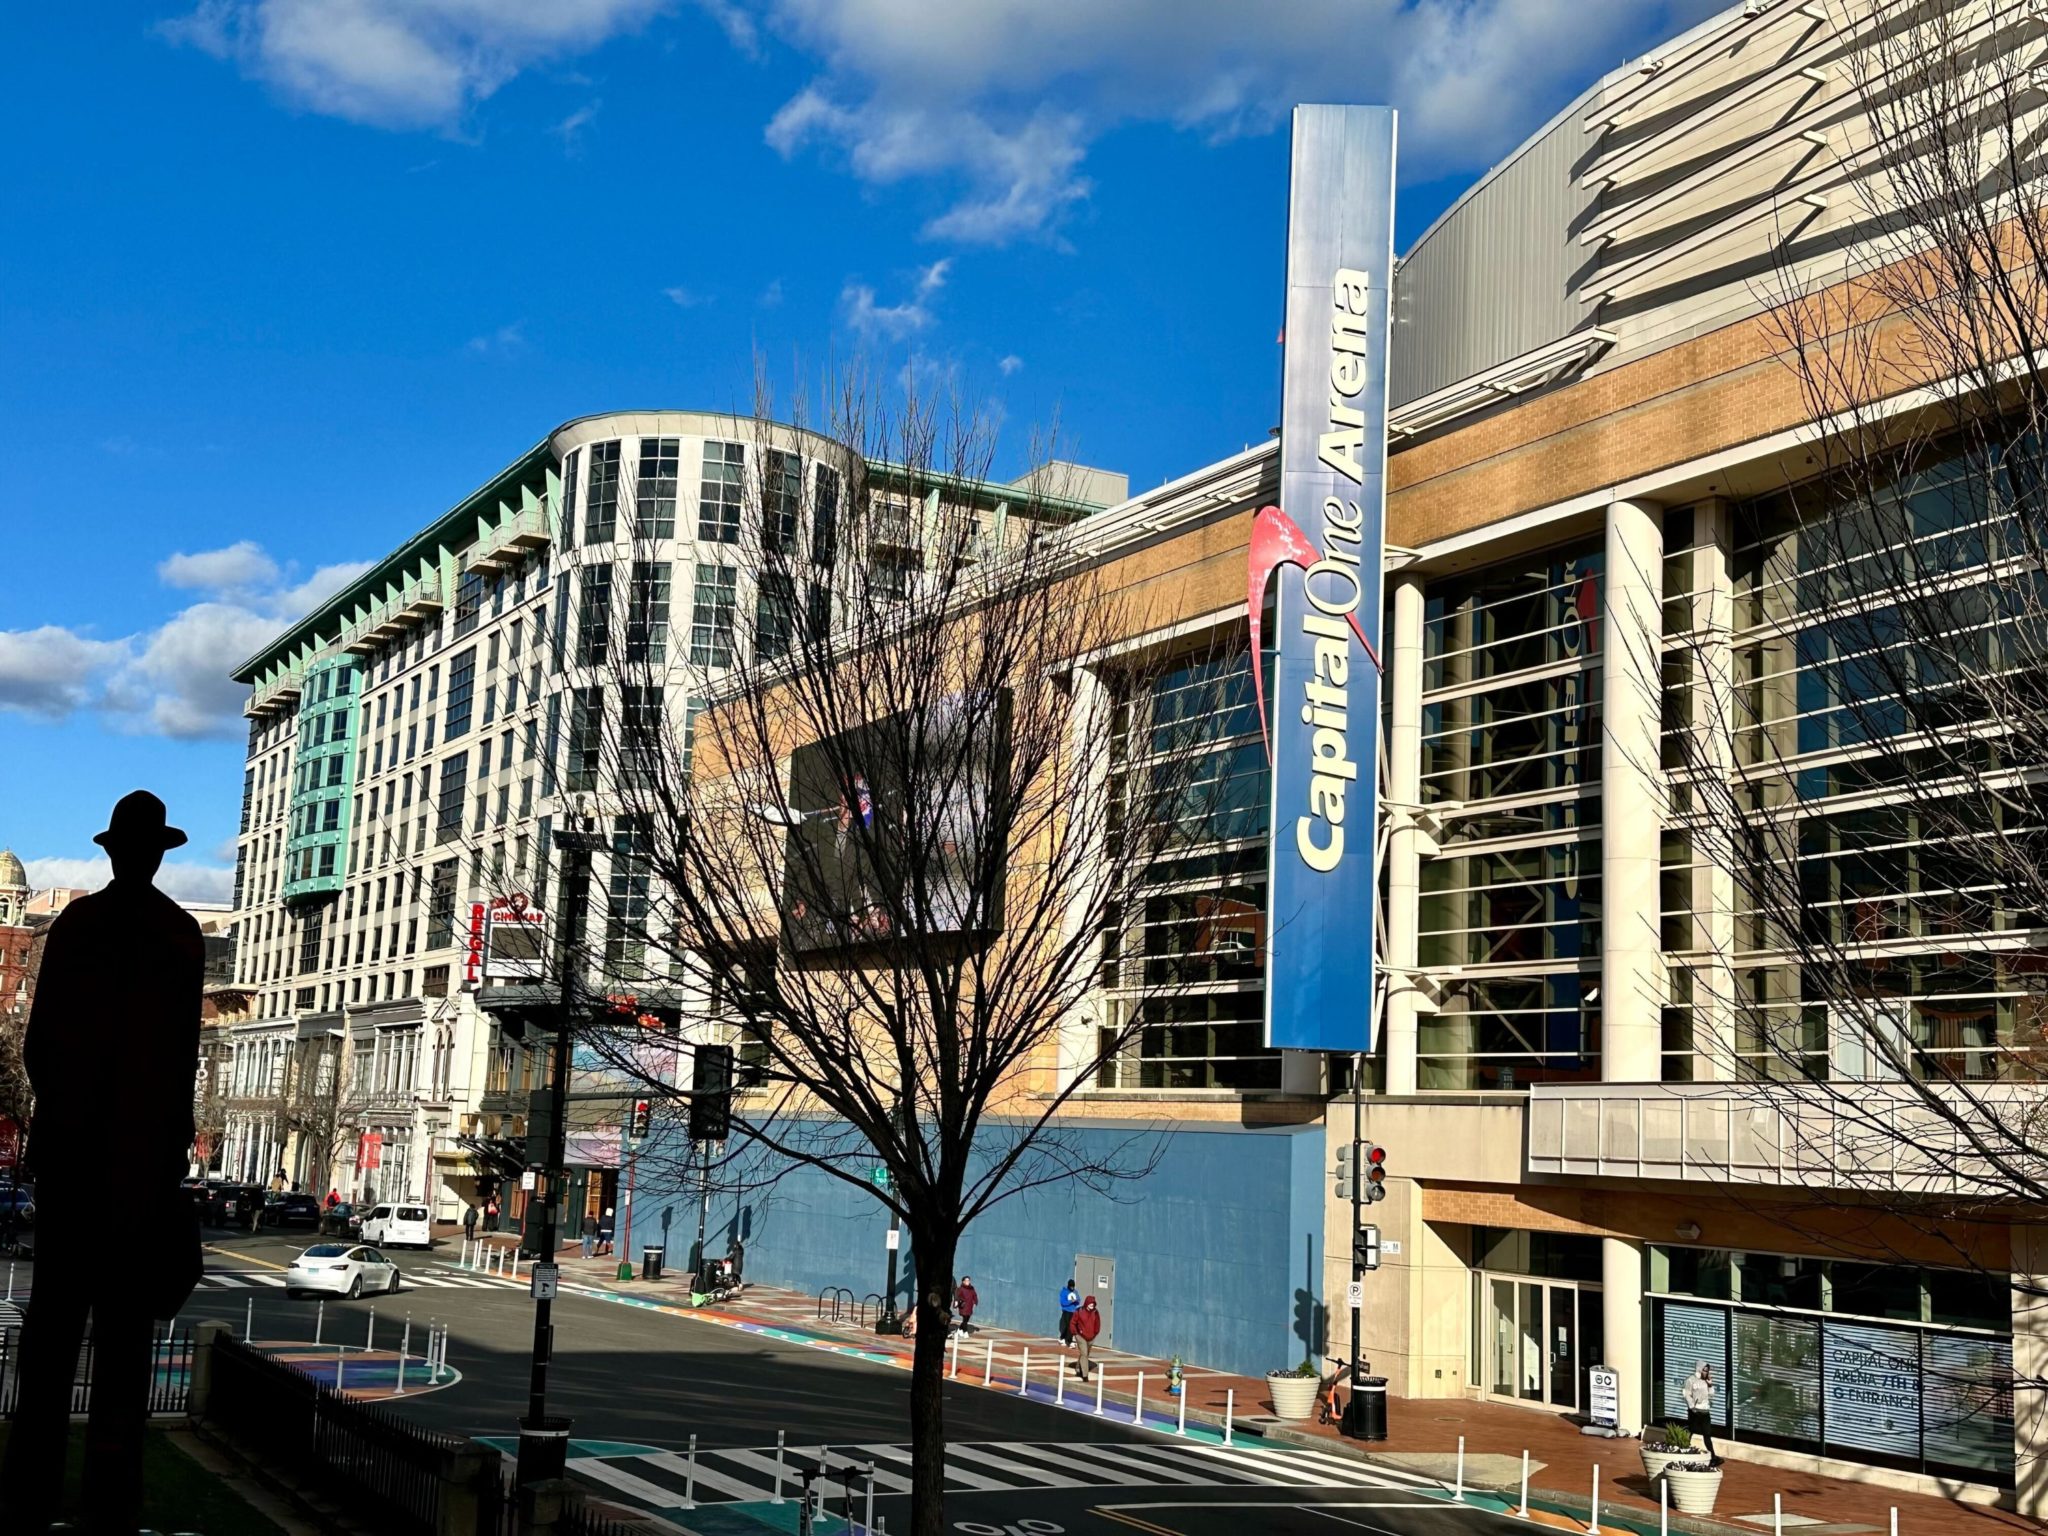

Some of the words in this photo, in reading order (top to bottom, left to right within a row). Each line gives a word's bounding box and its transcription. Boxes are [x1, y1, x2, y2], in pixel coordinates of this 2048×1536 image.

[1317, 268, 1369, 486] Arena
[467, 903, 485, 983] REGAL
[1833, 1349, 1883, 1369] CAPITAL
[1833, 1368, 1877, 1386] ARENA
[1881, 1374, 1907, 1390] 7TH
[1833, 1386, 1844, 1399] G
